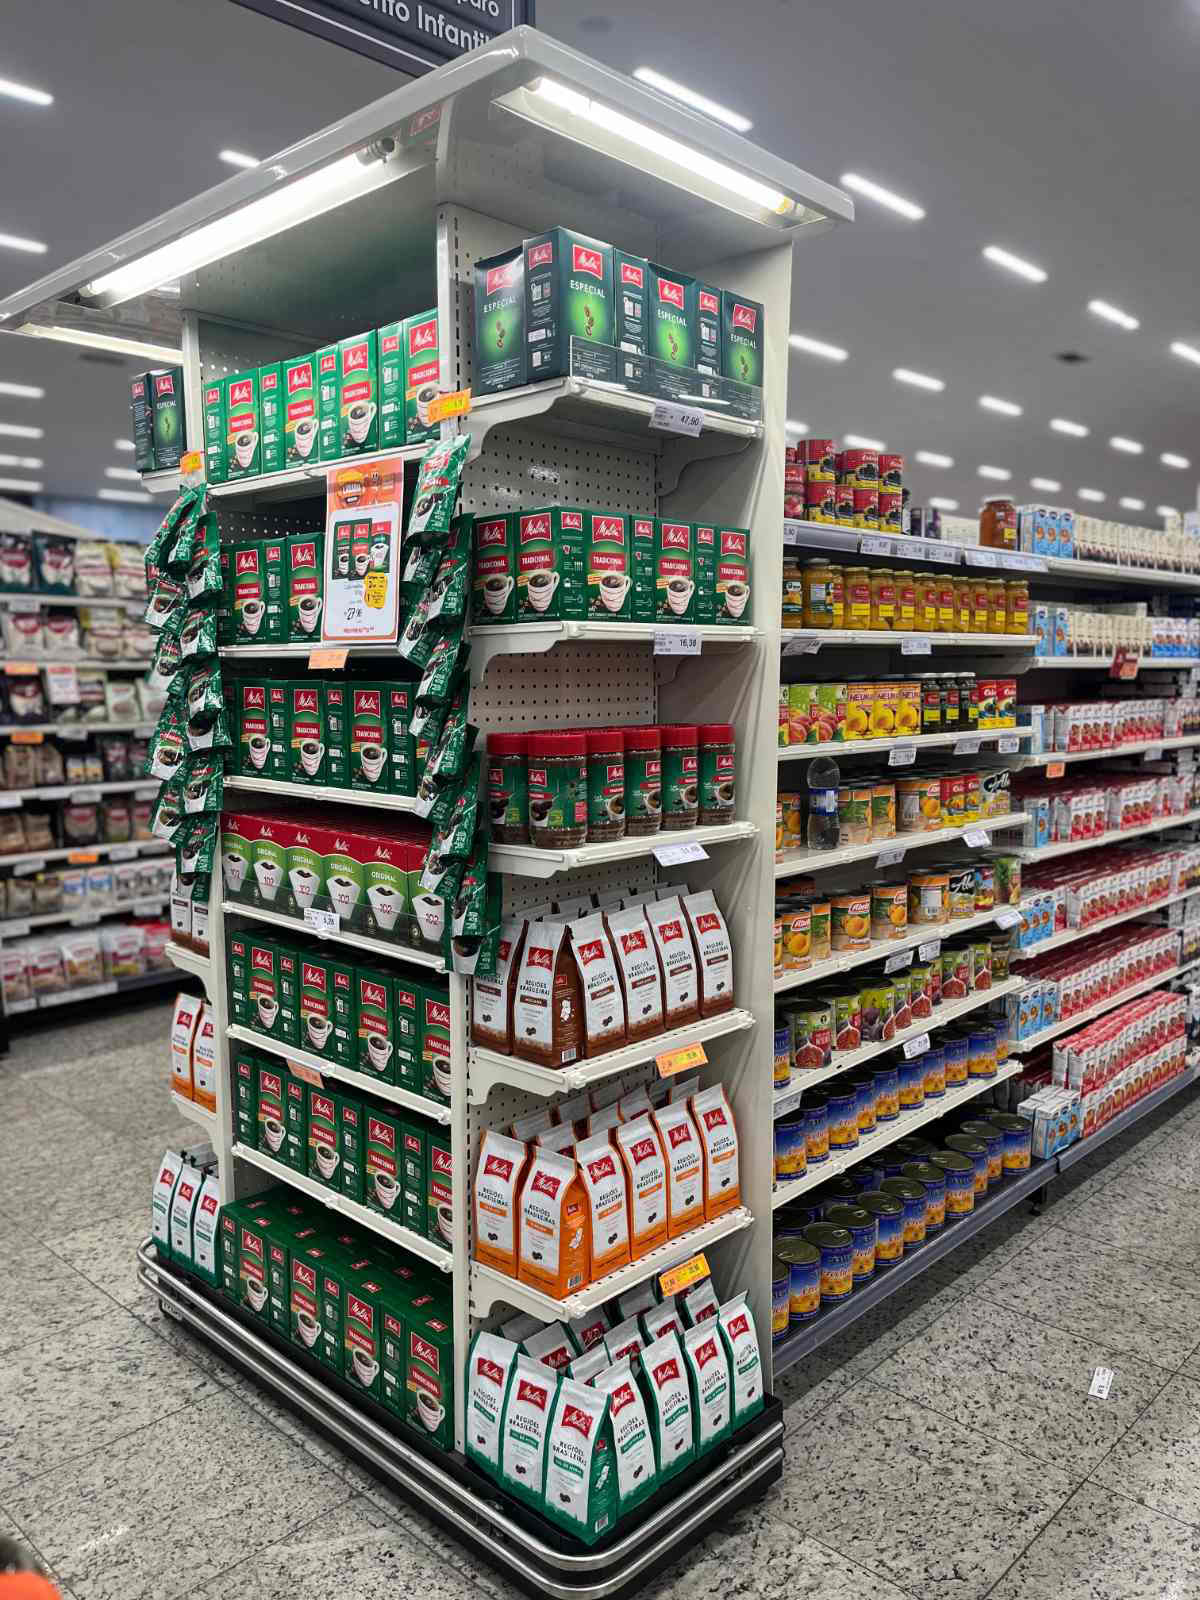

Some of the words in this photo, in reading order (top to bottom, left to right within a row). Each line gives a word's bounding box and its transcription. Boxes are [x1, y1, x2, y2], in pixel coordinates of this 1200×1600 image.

[457, 0, 500, 17] aro
[418, 5, 489, 51] Infanti
[570, 280, 606, 298] ESPECIAL
[657, 309, 688, 328] ESPECIAL
[521, 553, 551, 566] TRADICIONAL
[424, 912, 440, 925] 102
[515, 1414, 540, 1430] REGIÕES
[558, 1440, 585, 1456] REGIÕES
